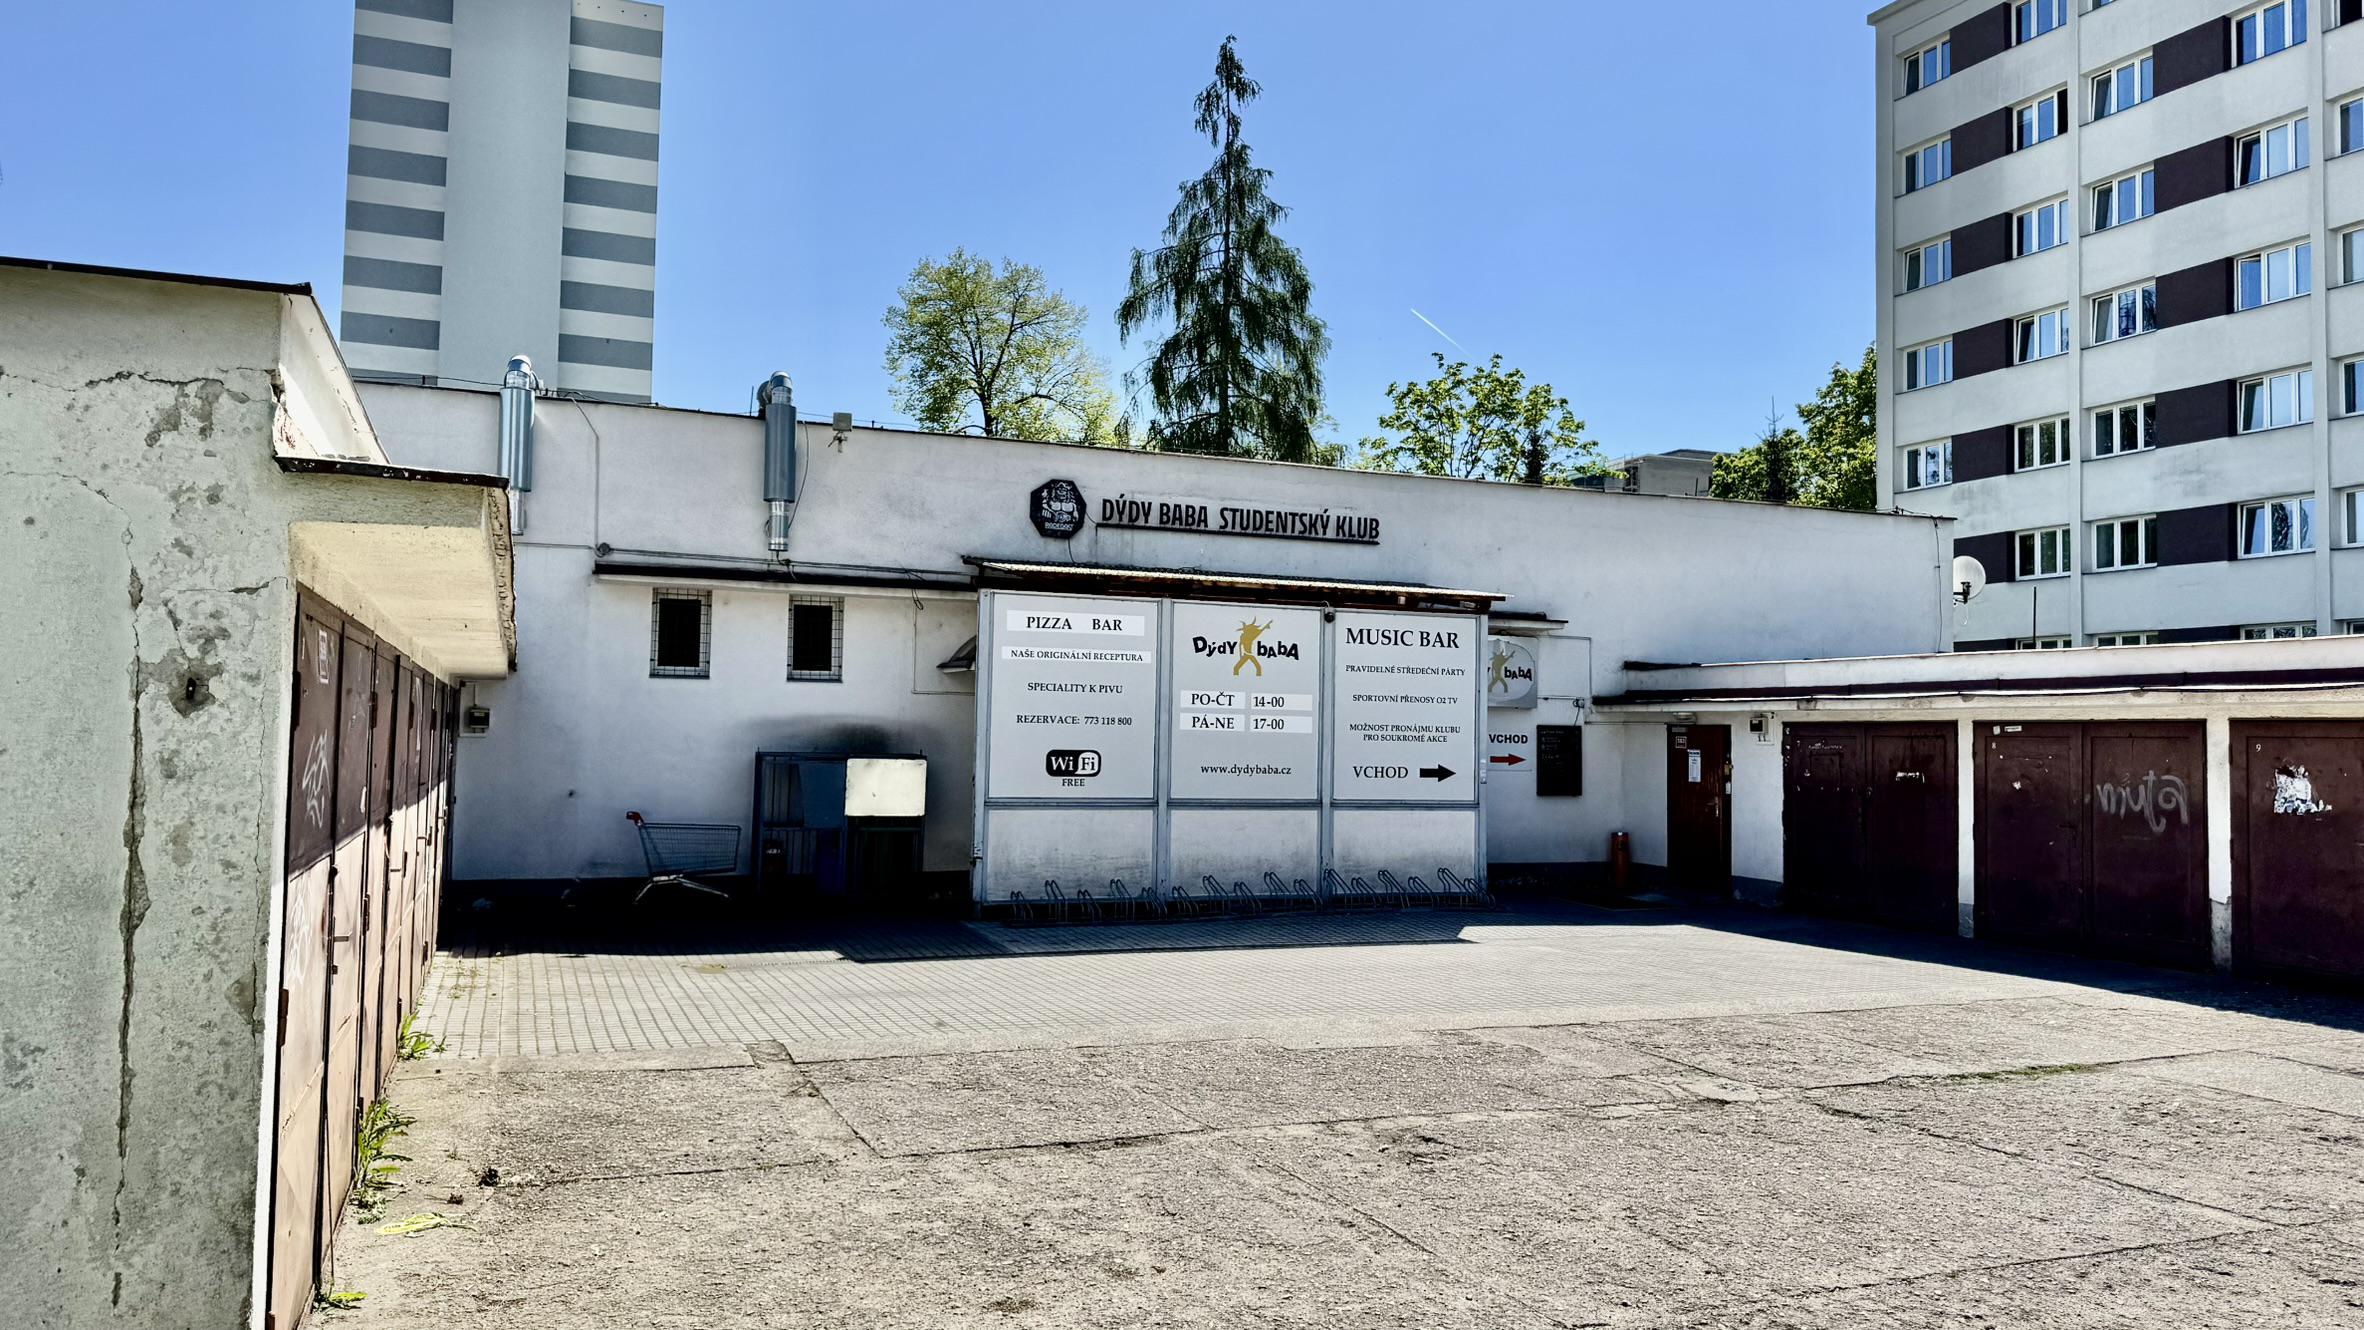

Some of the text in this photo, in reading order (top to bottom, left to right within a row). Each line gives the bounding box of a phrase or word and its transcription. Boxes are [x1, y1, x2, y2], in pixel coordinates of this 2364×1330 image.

[1102, 494, 1380, 539] DÝDY BABA STUDENTSKÝ KLUB
[1026, 616, 1122, 631] PIZZA BAR
[1346, 628, 1459, 648] MUSIC BAR
[1011, 649, 1143, 661] NAŠE ORIGINÁLNÍ RECEPTURA
[1346, 664, 1395, 673] PRAVIDELNÉ
[1027, 683, 1122, 693] SPECIALITY K PIVU
[1191, 692, 1284, 707] PO-ČT 14-00
[1353, 694, 1399, 703] SPORTOVNÍ
[1400, 695, 1435, 703] PŘENOSY
[1016, 715, 1132, 726] REZERVACE: 773 118 800
[1192, 714, 1284, 730] PÁ-NE 17-00
[1350, 723, 1389, 732] MOŽNOST
[1390, 724, 1433, 733] PRONÁJMU
[1381, 734, 1425, 742] SOUKROMÉ
[1489, 734, 1528, 744] VCHOD
[2255, 744, 2261, 752] 9
[1201, 764, 1291, 776] www.dydybaba.cz
[1353, 766, 1408, 778] VCHOD
